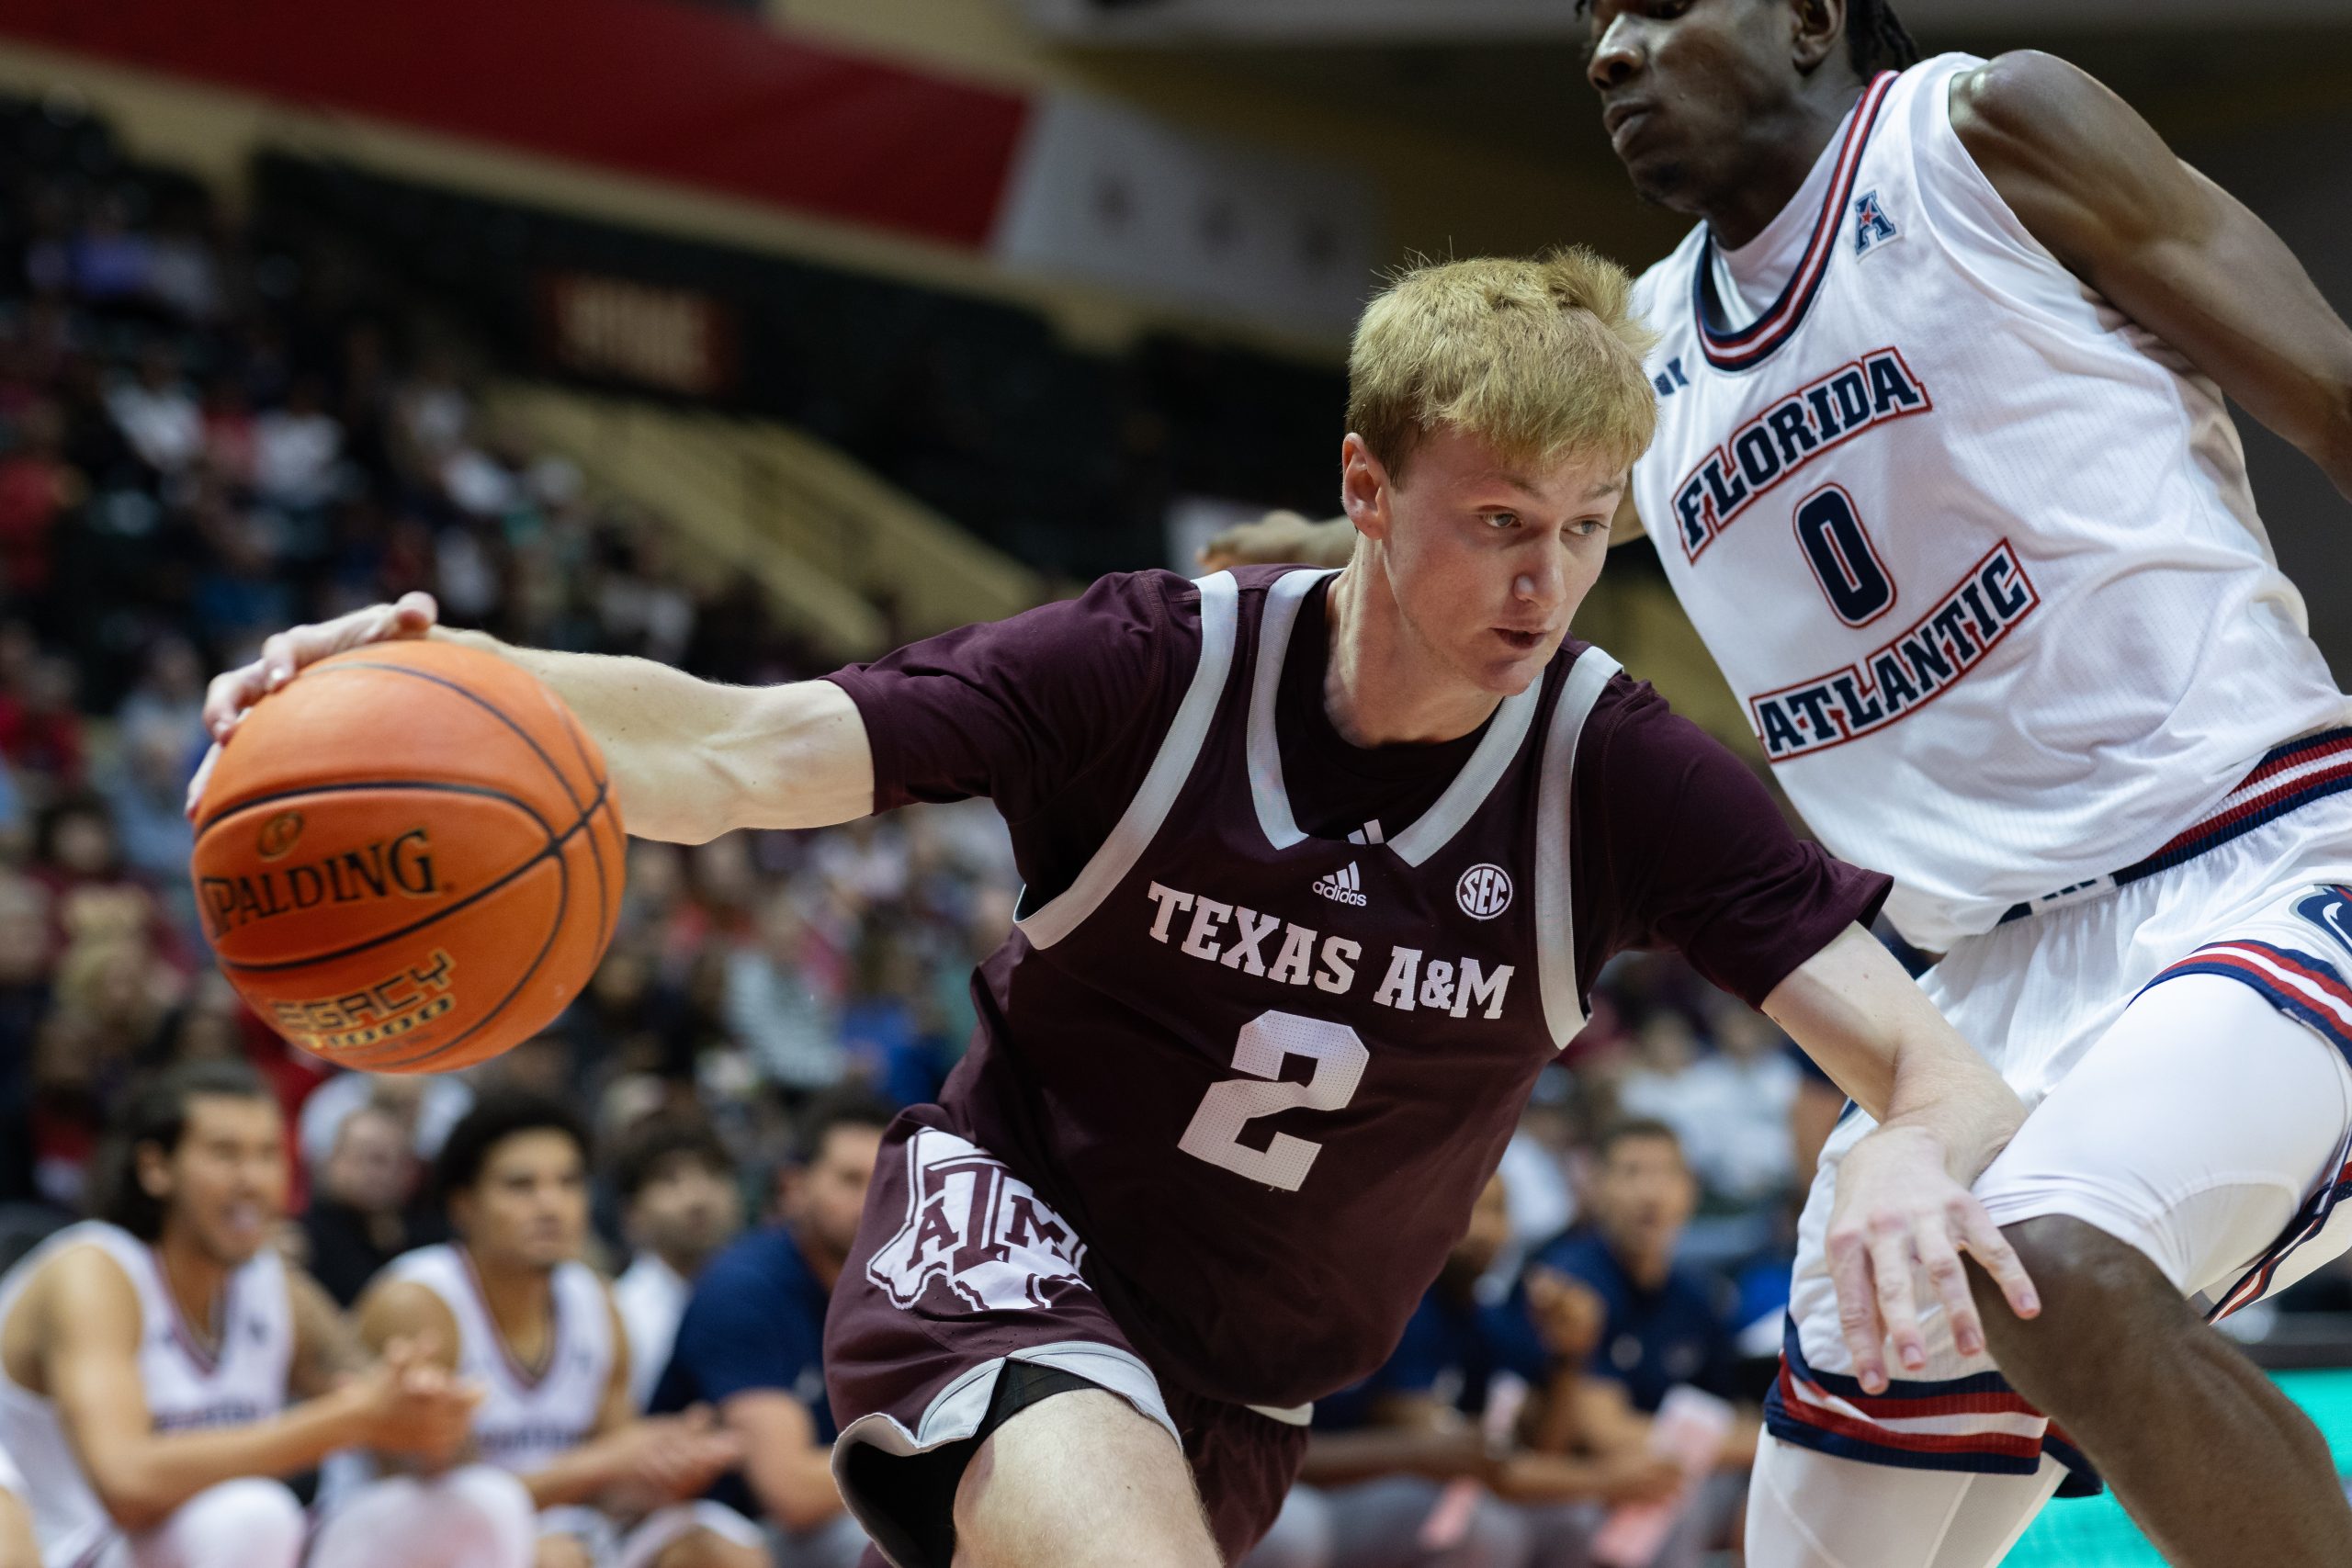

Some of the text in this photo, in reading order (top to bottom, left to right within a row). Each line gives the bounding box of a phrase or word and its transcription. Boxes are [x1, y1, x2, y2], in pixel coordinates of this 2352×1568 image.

[1673, 348, 1931, 562] FLORIDA
[1794, 483, 1895, 627] 0
[1751, 539, 2039, 761] ATLANTIC
[1148, 881, 1515, 1020] TEXAS A&M
[1312, 879, 1368, 908] adidas
[1459, 866, 1511, 918] SEC
[1177, 1010, 1370, 1192] 2
